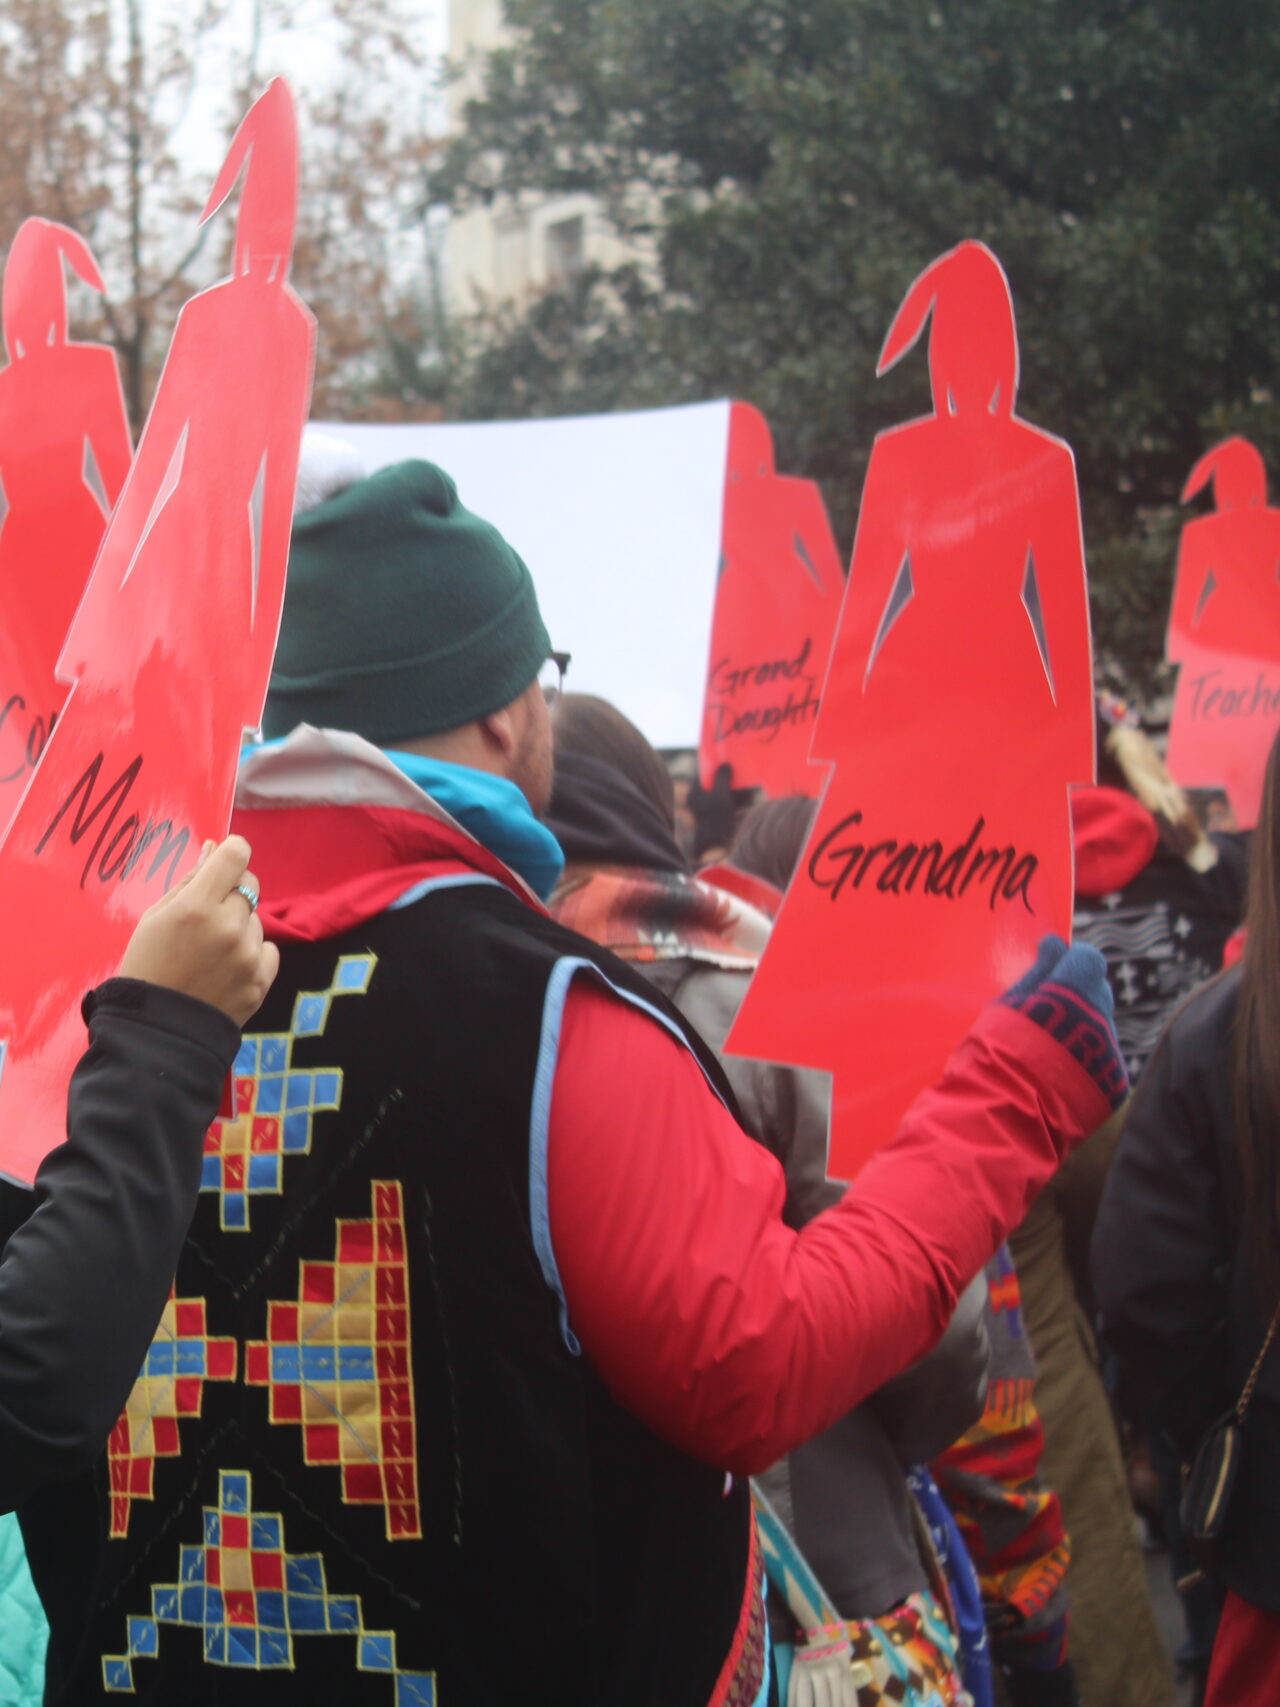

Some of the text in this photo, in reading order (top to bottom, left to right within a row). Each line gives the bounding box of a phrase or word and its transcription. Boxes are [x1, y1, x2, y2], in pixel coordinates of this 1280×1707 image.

[708, 676, 821, 744] Daught
[709, 636, 812, 697] Grand
[34, 751, 191, 894] Mom
[808, 810, 1039, 916] Grandma
